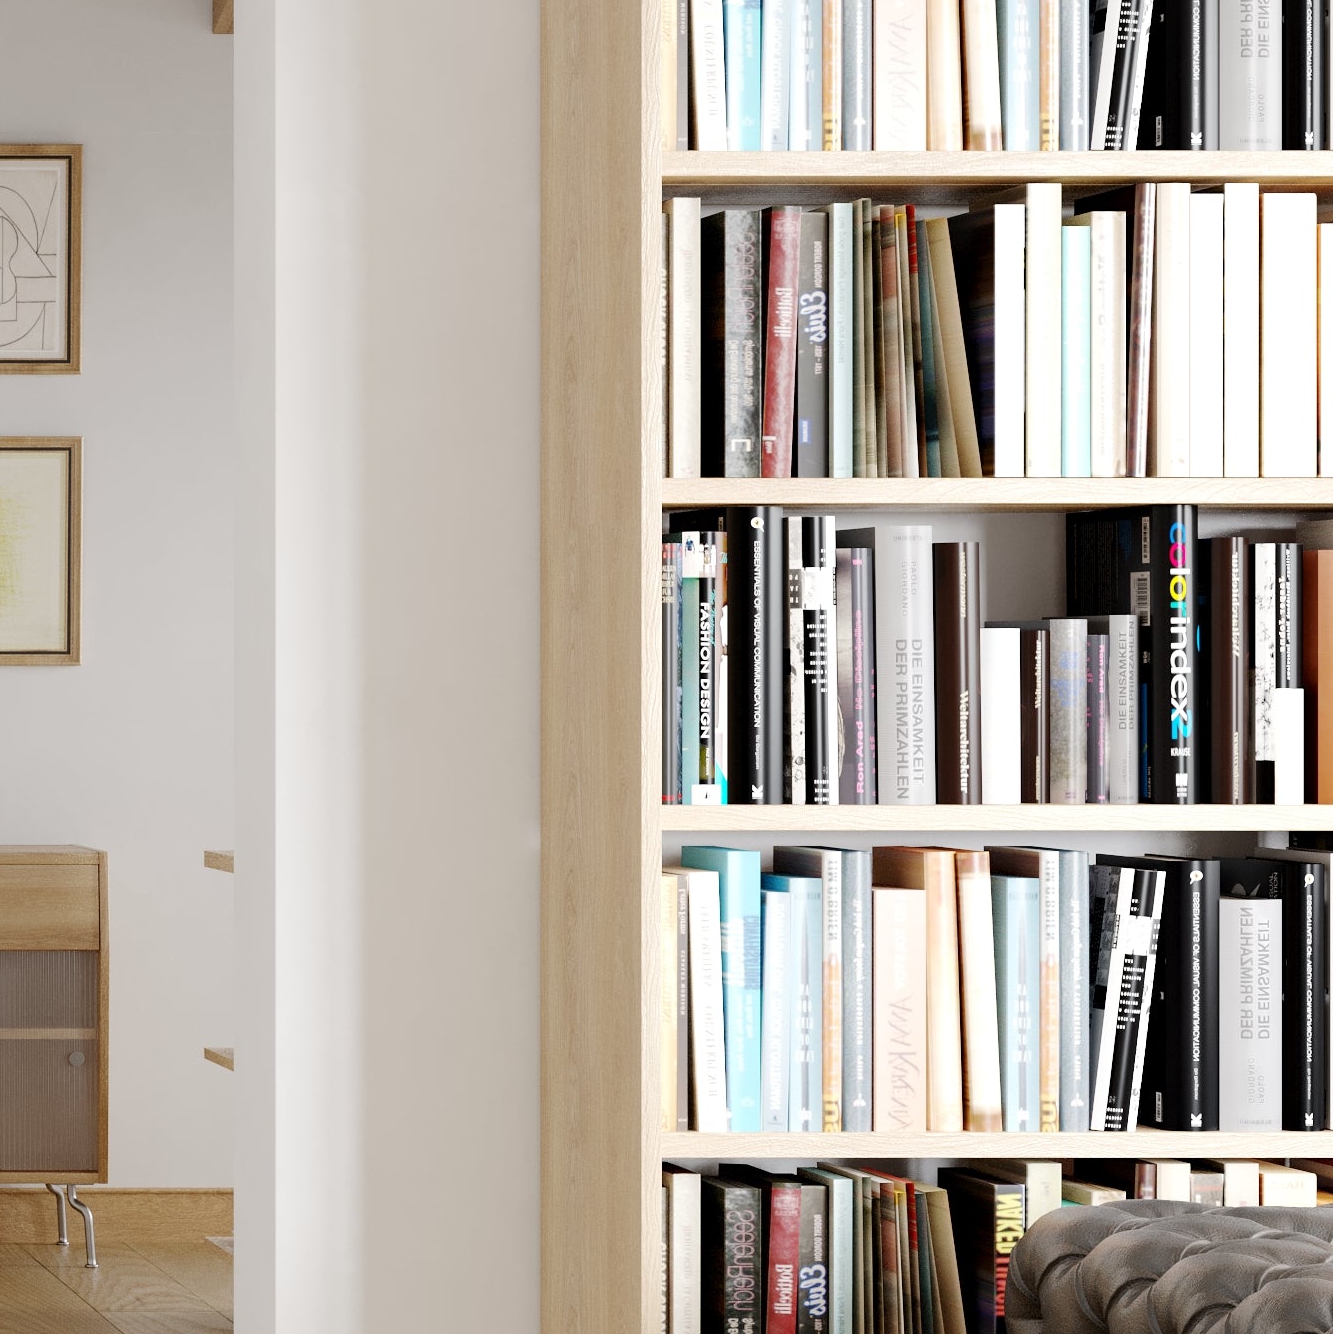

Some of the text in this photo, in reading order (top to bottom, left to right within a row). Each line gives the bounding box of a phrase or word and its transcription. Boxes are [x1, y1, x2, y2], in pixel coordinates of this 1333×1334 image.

[699, 602, 710, 739] FASHION DESIGN
[753, 541, 761, 728] ESSENTIALS OF VISUAL COMMUNICATION
[1118, 632, 1127, 730] DIE EINSAMKEIT
[1169, 522, 1192, 740] colorindex2
[855, 721, 864, 793] Ron Arad
[895, 639, 909, 799] DER PRIMZAHLEN
[911, 639, 924, 784] DIE EINSAMKEIT
[959, 690, 969, 793] Weltarchitektur
[1170, 748, 1190, 757] KRAUSE
